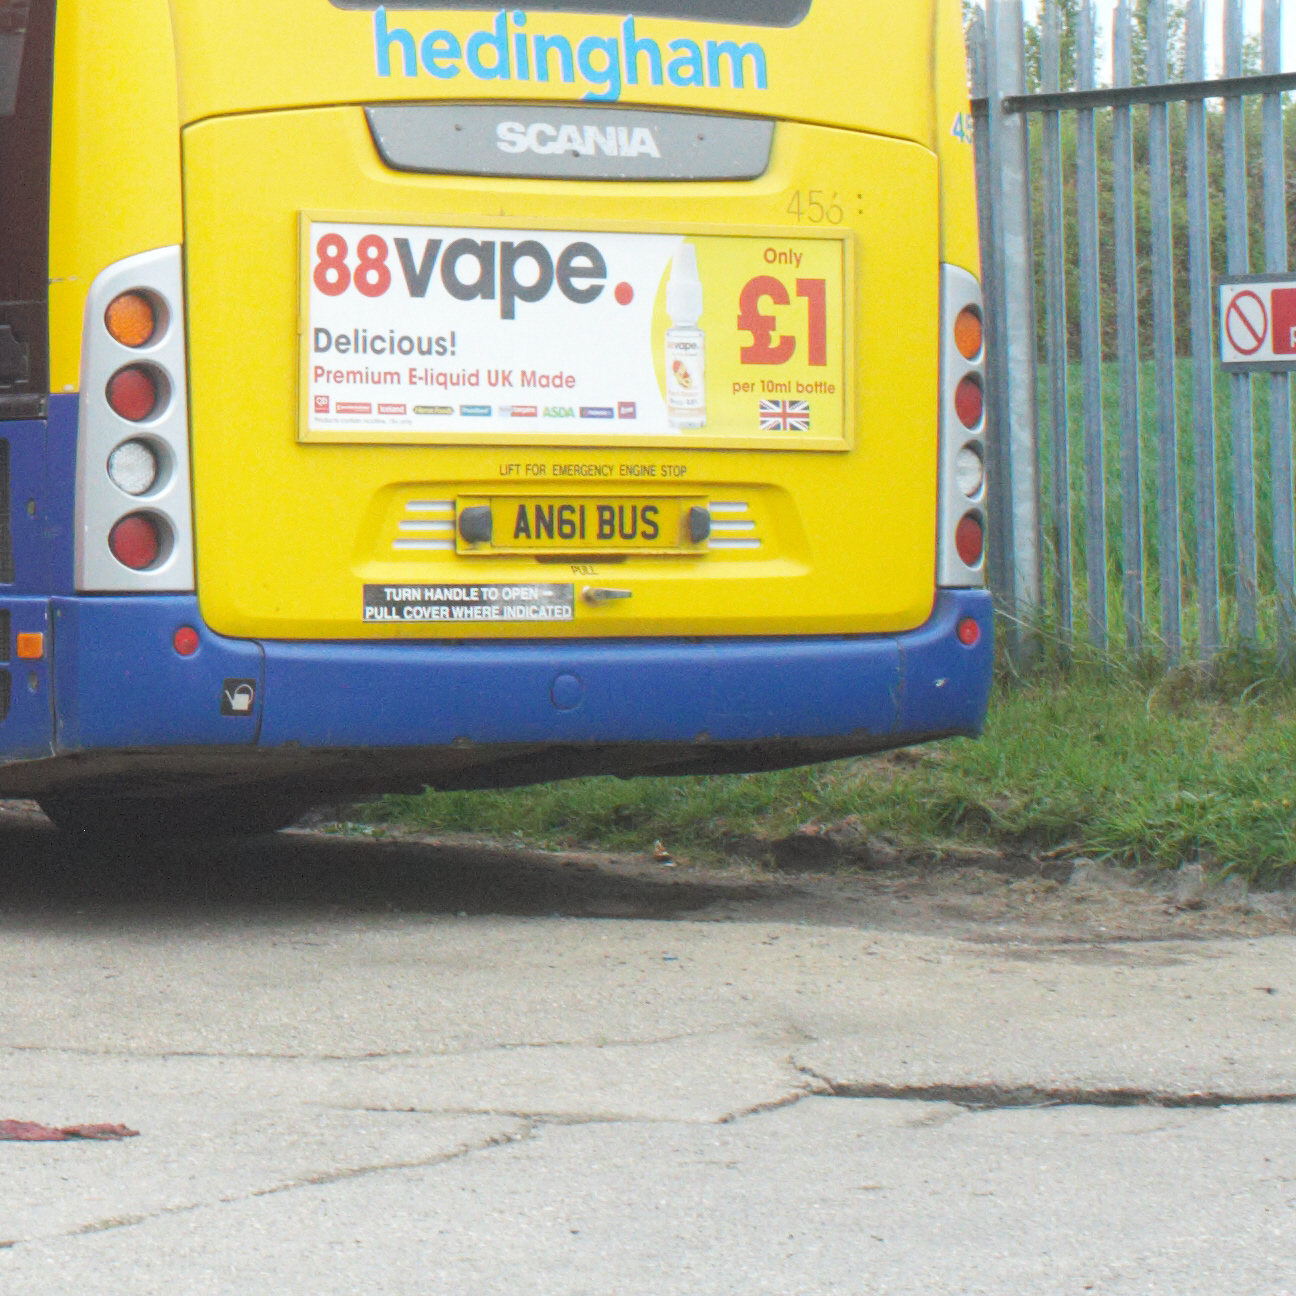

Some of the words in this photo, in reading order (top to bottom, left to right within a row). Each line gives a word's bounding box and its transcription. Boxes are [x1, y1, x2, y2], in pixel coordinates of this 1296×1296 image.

[373, 6, 769, 102] hedingham
[496, 122, 660, 158] SCANIA
[787, 189, 844, 225] 456
[764, 247, 803, 268] Only
[737, 275, 827, 366] £1
[313, 327, 457, 356] Delicious!
[313, 365, 401, 385] Premium
[408, 367, 480, 390] E-liquid
[487, 369, 513, 387] UK
[520, 370, 576, 388] Made
[732, 382, 755, 395] per
[761, 380, 791, 394] 10ml
[796, 381, 835, 394] bottle
[542, 406, 575, 418] ASDA
[499, 463, 521, 476] LIFT
[525, 464, 546, 476] FOR
[552, 464, 615, 477] EMERGENCY
[619, 464, 656, 477] ENGINE
[660, 465, 687, 477] STOP
[514, 504, 586, 540] AN61
[596, 505, 660, 540] BUS
[384, 587, 422, 601] TURN
[424, 587, 479, 601] HANDLE
[481, 587, 499, 601] TO
[502, 587, 538, 601] OPEN
[365, 606, 400, 620] PULL
[404, 606, 450, 620] COVER
[451, 606, 500, 618] WHERE
[503, 605, 572, 618] INDICATED
